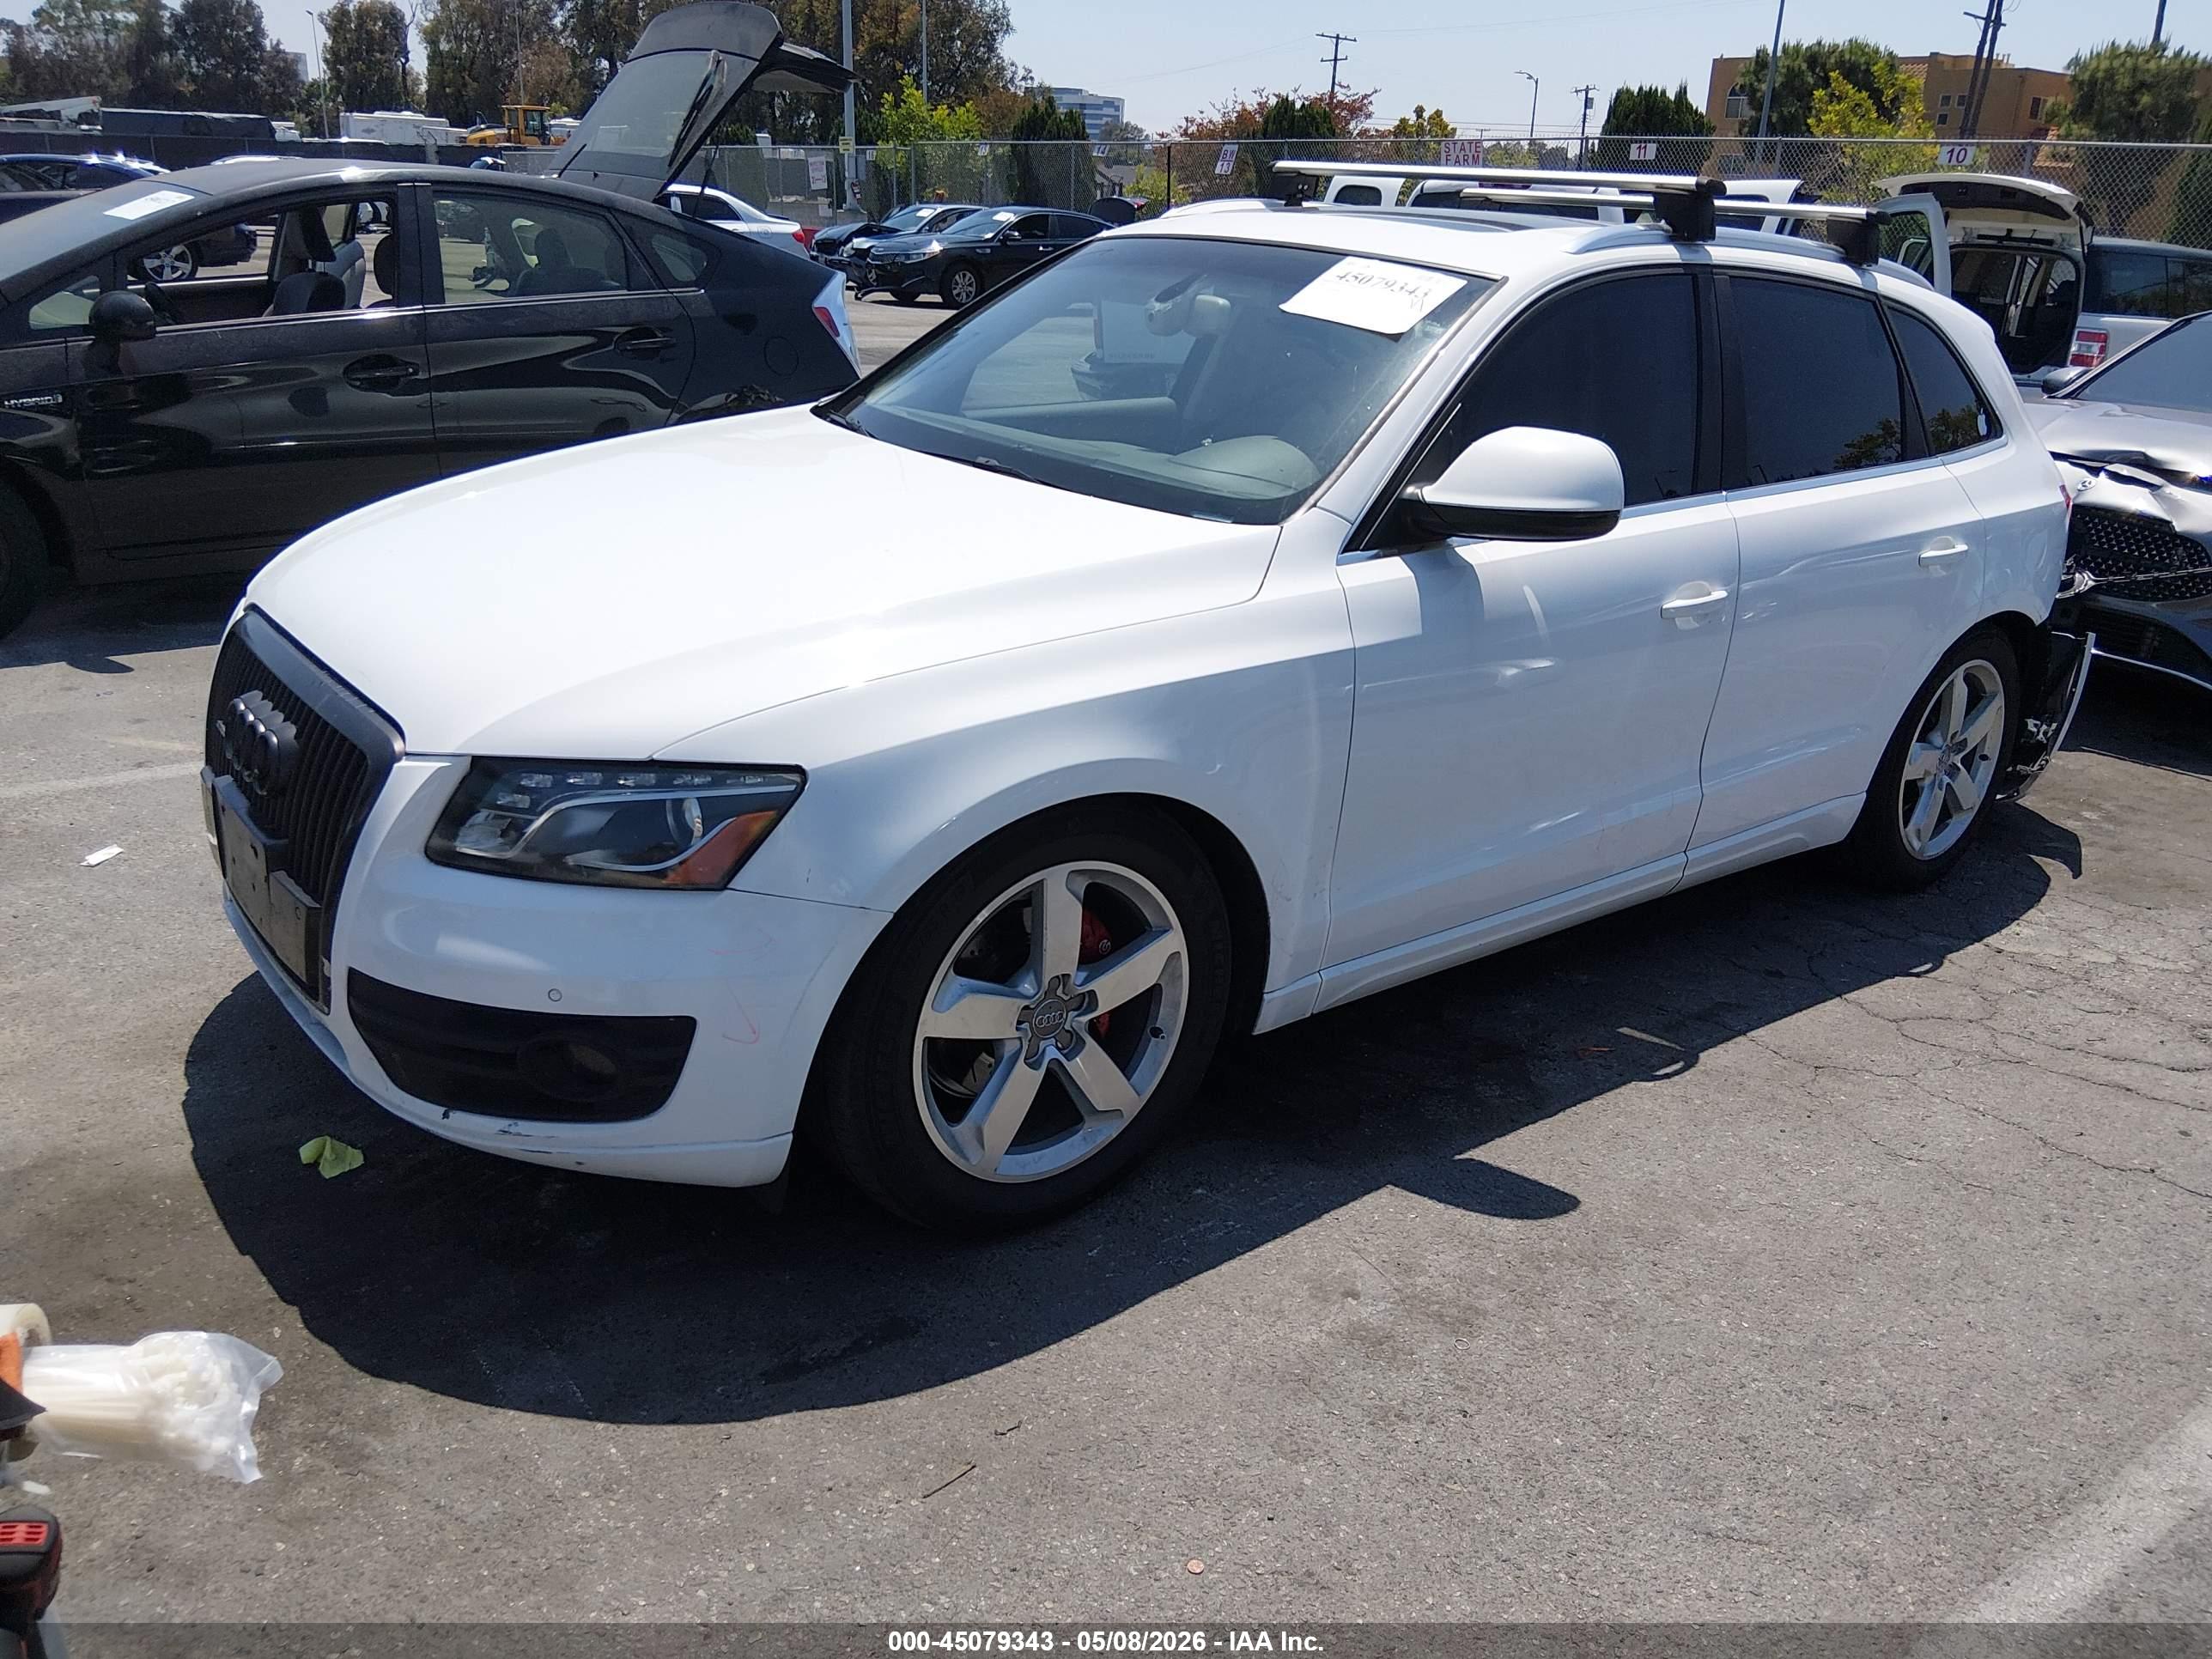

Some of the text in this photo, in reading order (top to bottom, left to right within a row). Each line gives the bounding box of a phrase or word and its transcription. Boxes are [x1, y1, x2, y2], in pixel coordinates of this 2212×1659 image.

[1443, 142, 1481, 154] STATE
[1636, 143, 1647, 159] 11
[1222, 149, 1237, 160] BW
[1445, 154, 1480, 166] FARM
[1947, 147, 1968, 164] 10
[1219, 162, 1231, 173] 13
[1335, 270, 1432, 300] 45079343
